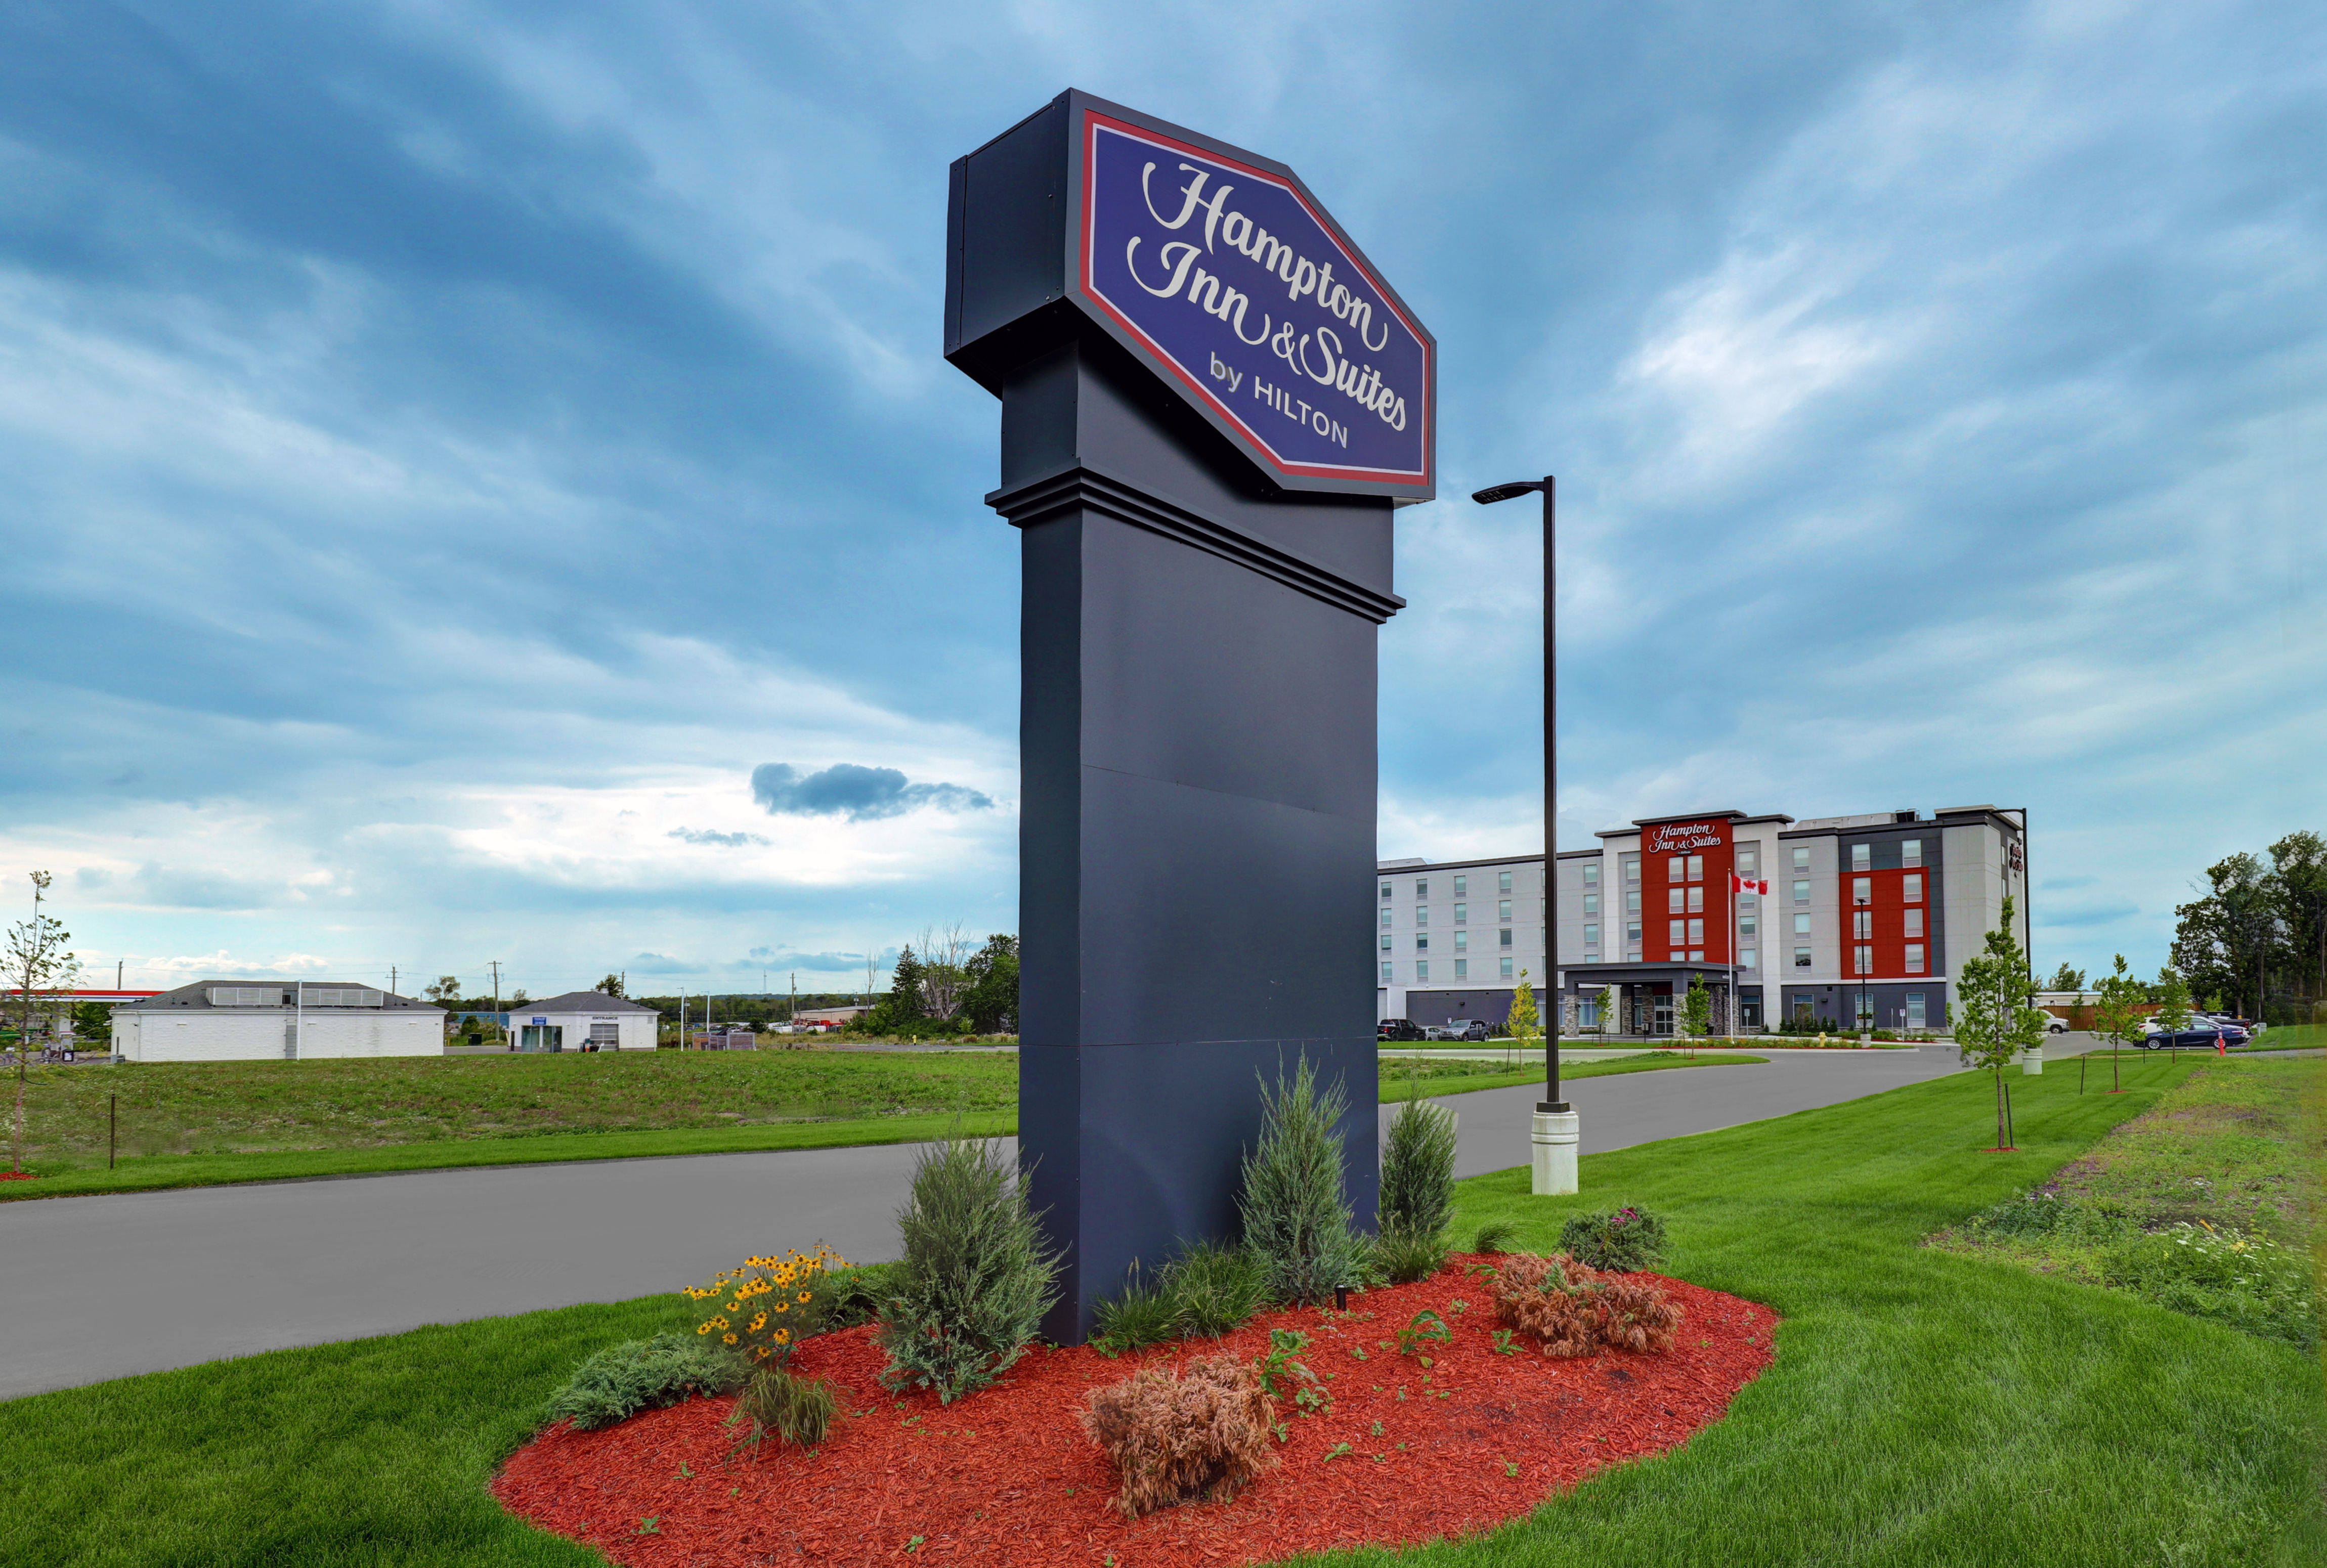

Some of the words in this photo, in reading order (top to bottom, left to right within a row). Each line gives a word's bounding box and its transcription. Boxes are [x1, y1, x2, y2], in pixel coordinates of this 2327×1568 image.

[1143, 162, 1388, 351] Hampton
[1127, 236, 1270, 345] Inn
[1272, 322, 1302, 375] &
[1300, 327, 1405, 431] Suites
[1211, 352, 1242, 392] by
[1255, 376, 1347, 448] HILTON
[1649, 840, 1680, 853] Inn
[1679, 840, 1688, 849] &
[1687, 836, 1721, 848] Suites
[1653, 823, 1715, 841] Hampton
